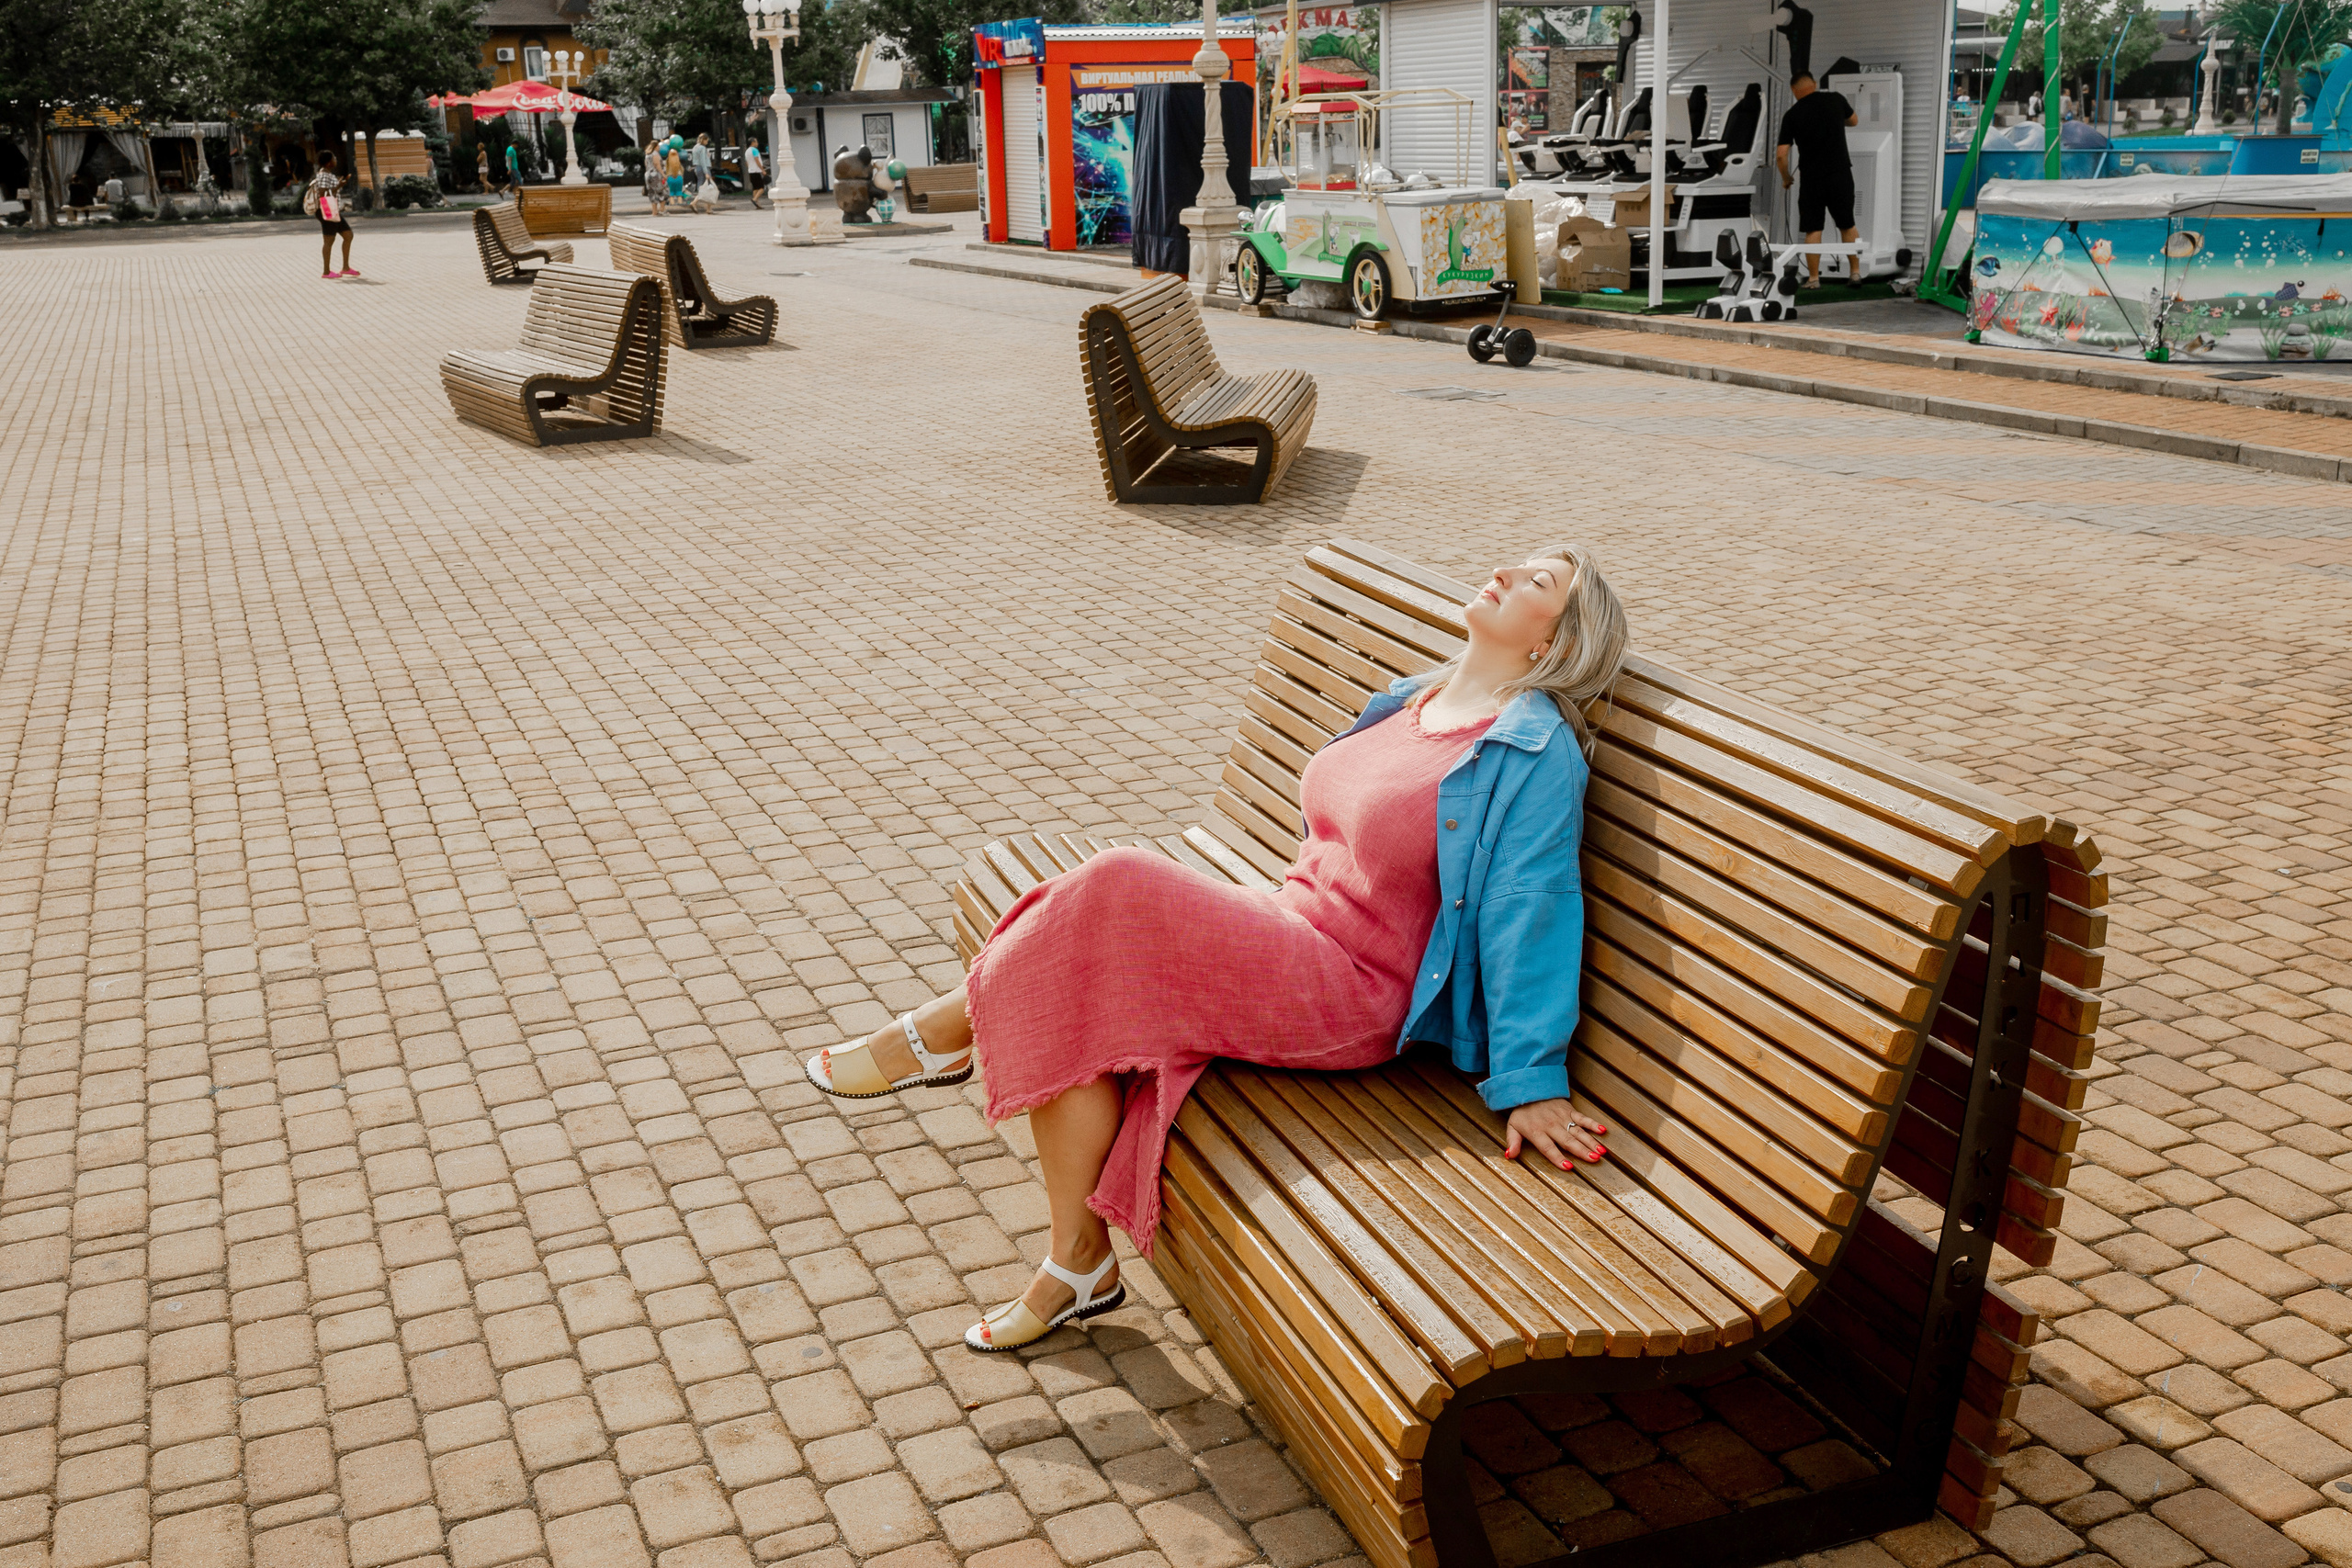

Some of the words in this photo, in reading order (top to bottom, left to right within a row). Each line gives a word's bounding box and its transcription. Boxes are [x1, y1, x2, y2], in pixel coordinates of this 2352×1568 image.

[975, 33, 1005, 65] VR
[1080, 71, 1155, 85] ВИРТУАЛЬНАЯ
[1156, 71, 1204, 83] РЕАЛЬНО
[1079, 93, 1121, 112] 100%
[1442, 271, 1488, 279] КУКУРУЗКИН
[1988, 892, 2031, 1092] ПАРК
